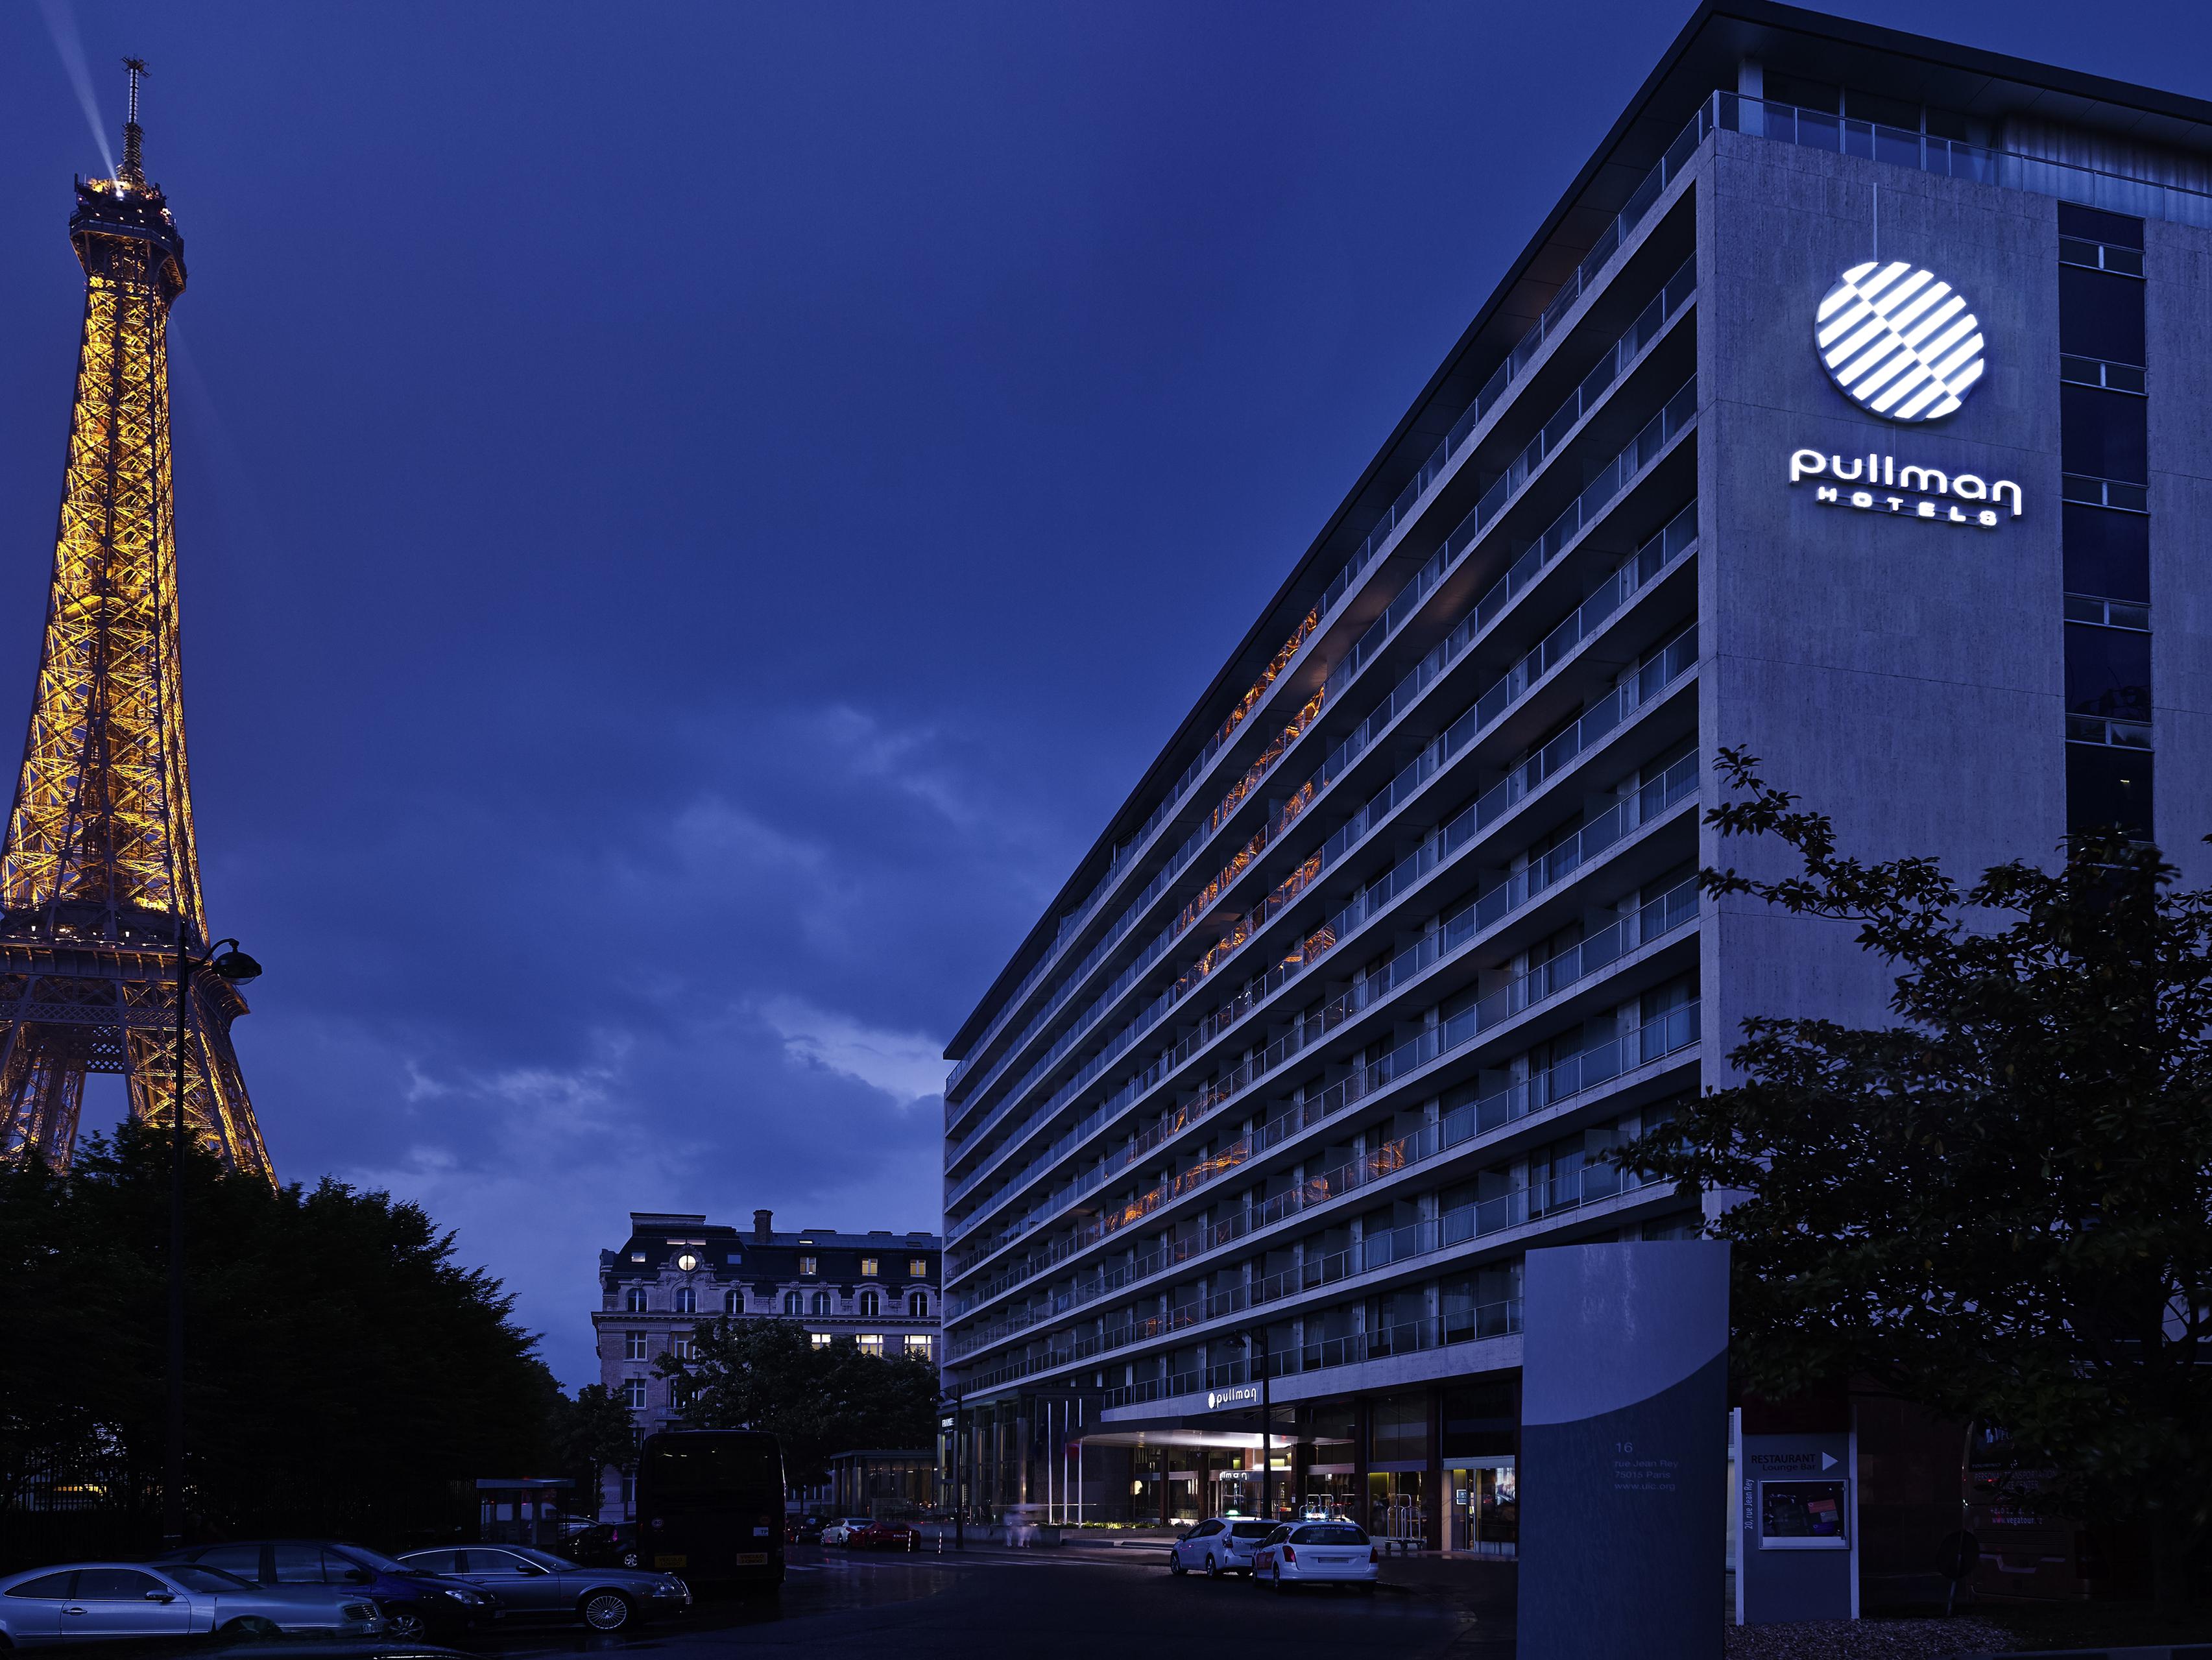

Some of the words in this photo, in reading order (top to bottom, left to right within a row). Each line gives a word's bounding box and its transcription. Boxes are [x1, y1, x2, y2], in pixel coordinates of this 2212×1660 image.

[1790, 450, 2022, 517] pullman
[1817, 486, 1998, 527] HOTELS
[1216, 1388, 1256, 1408] pullman
[1615, 1442, 1633, 1453] 16
[1660, 1460, 1679, 1469] Rey
[1751, 1454, 1816, 1464] RESTAURANT
[1615, 1471, 1643, 1479] 75015
[1646, 1471, 1672, 1479] Paris
[1614, 1482, 1676, 1492] www.uic.org
[1744, 1478, 1754, 1491] Rey
[1744, 1491, 1753, 1506] Jean
[1744, 1519, 1754, 1530] 20,
